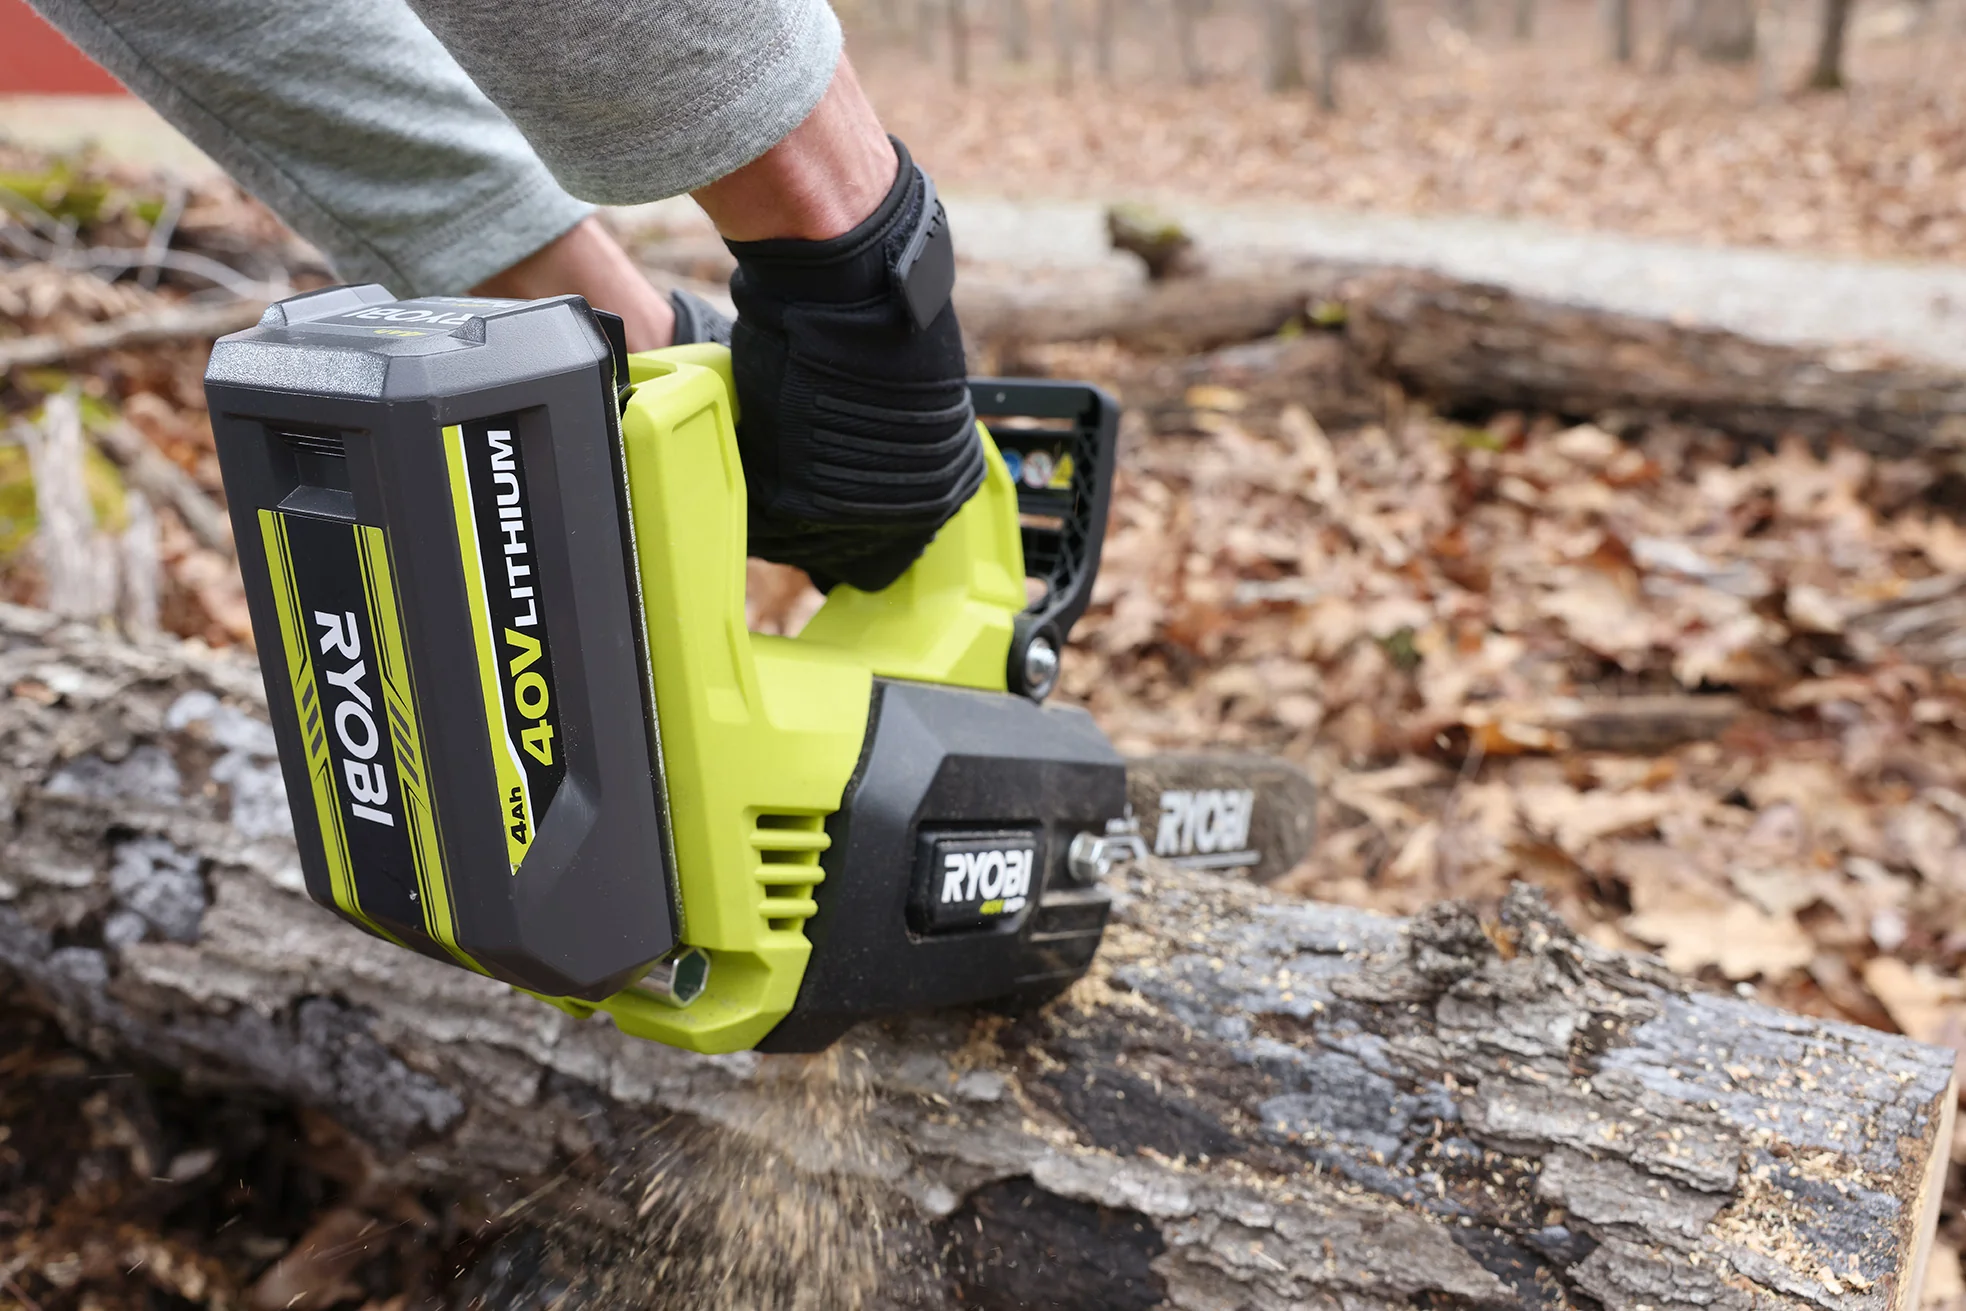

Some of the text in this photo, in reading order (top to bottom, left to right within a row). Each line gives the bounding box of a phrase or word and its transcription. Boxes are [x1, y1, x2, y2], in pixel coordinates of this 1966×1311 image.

[342, 307, 475, 325] RYOBI
[486, 430, 554, 766] 40V LITHIUM
[314, 610, 395, 827] RYOBI
[509, 786, 527, 845] 4Ah
[1154, 789, 1255, 857] RYOBI
[941, 848, 1034, 904] RYOBI
